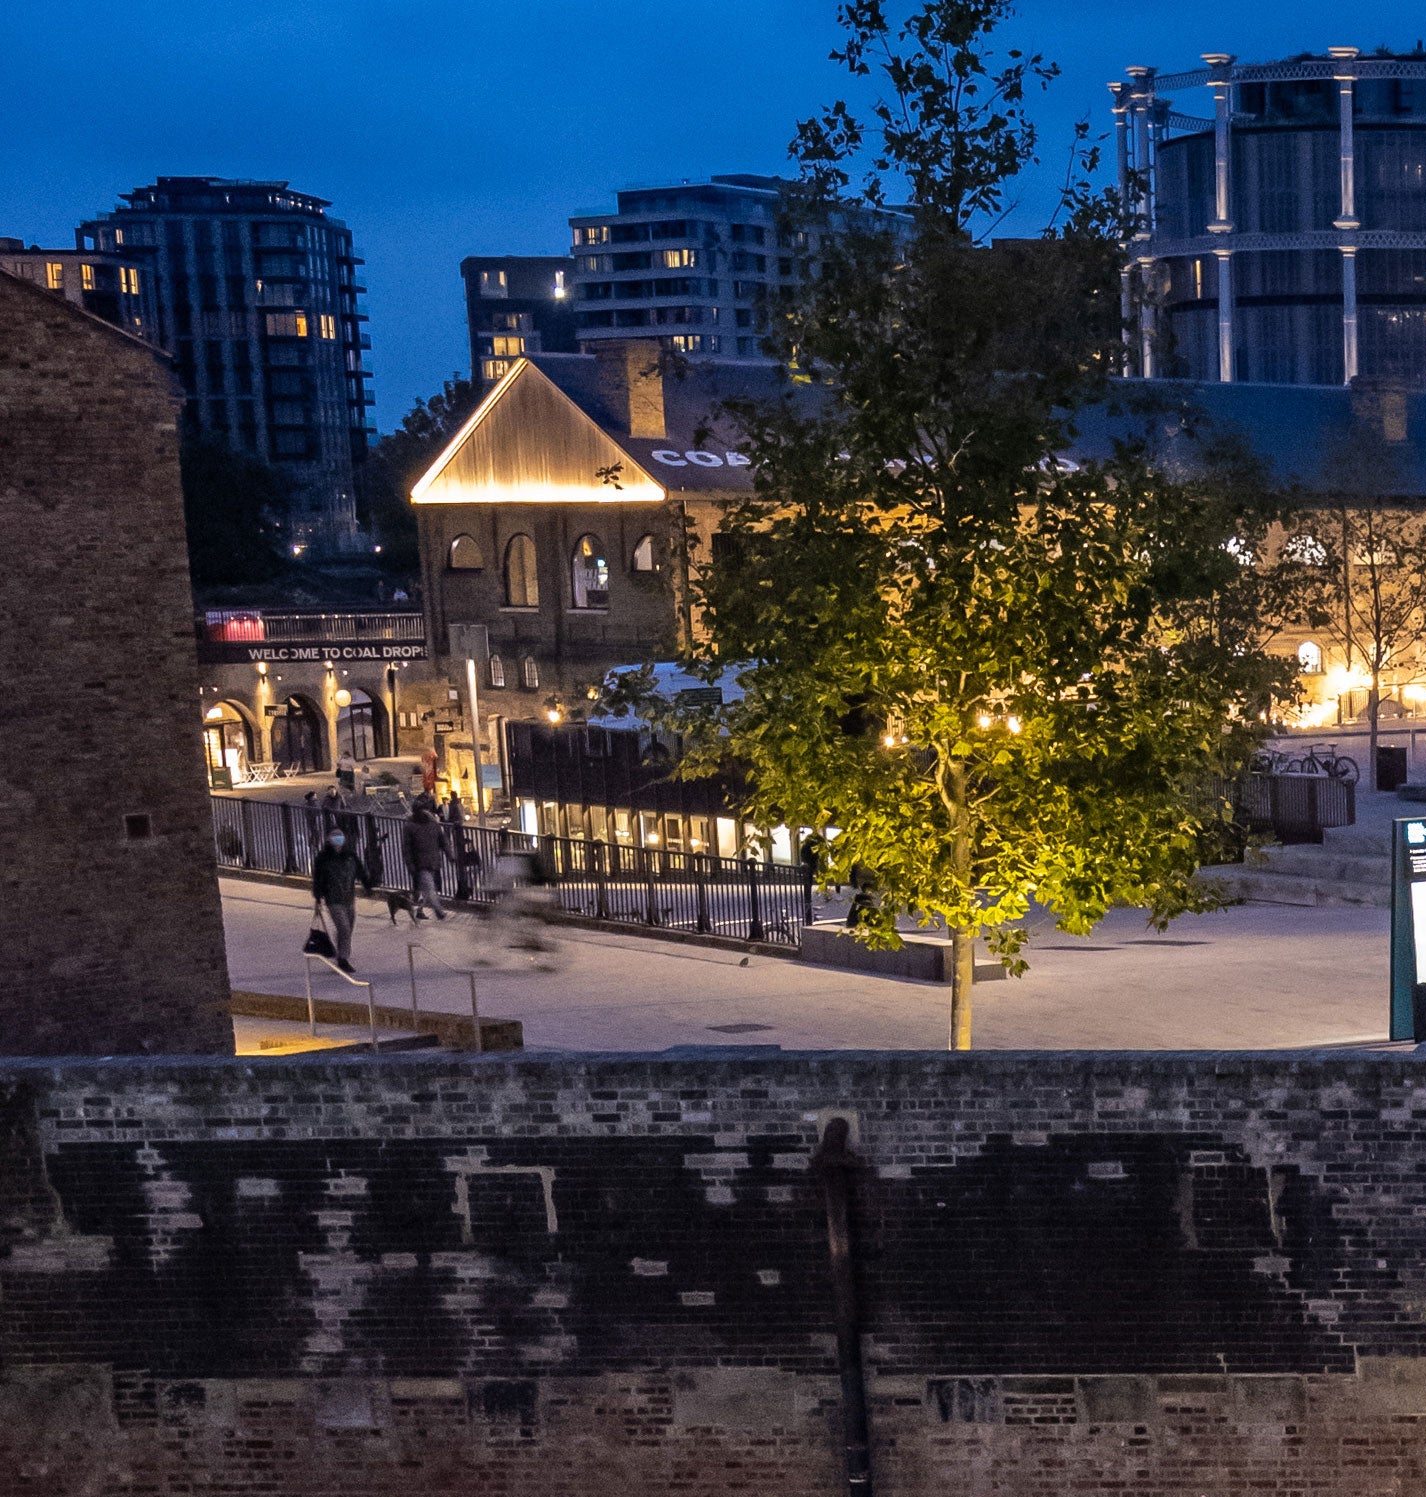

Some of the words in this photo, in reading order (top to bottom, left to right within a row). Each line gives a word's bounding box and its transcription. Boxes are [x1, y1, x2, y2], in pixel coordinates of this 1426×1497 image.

[248, 648, 319, 660] WELCOME
[322, 647, 341, 659] TO
[343, 646, 380, 658] COAL
